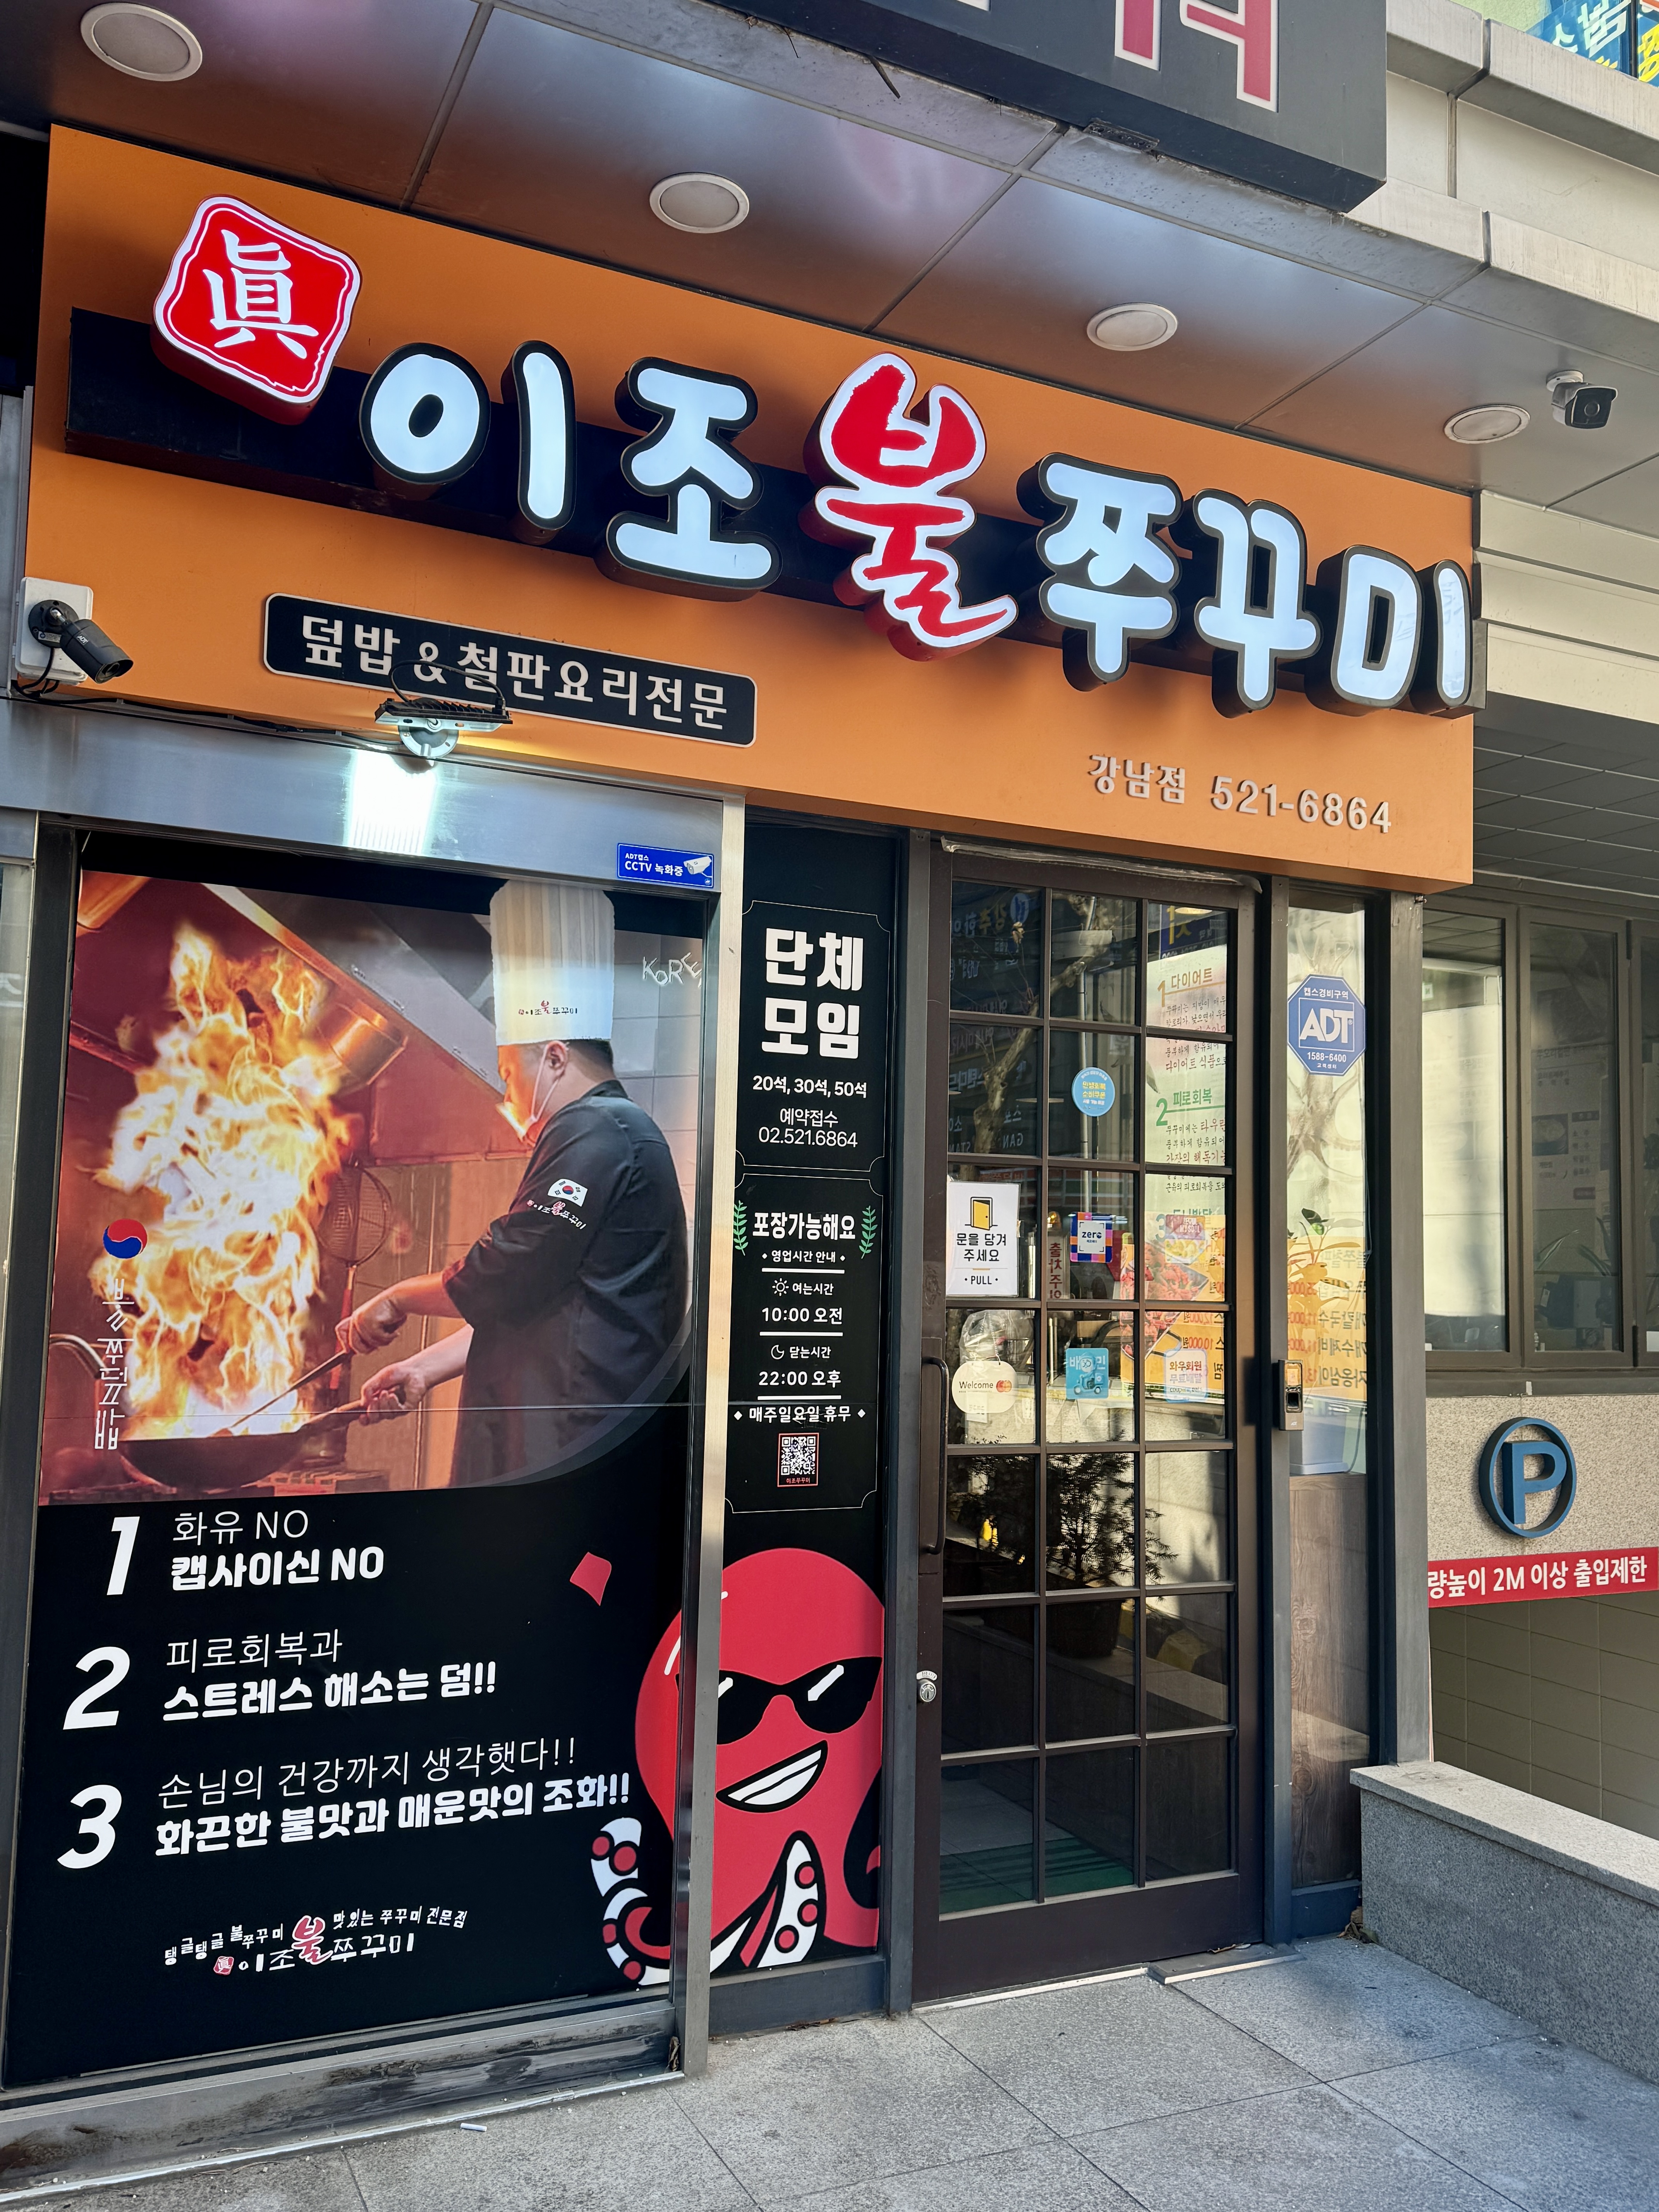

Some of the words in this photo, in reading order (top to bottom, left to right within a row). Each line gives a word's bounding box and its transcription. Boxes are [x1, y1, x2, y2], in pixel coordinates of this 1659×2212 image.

[203, 230, 318, 357] 眞
[77, 635, 88, 644] ADT
[302, 616, 400, 676] 덮밥
[414, 642, 447, 683] &
[458, 642, 728, 730] 철판요리전문
[1089, 754, 1185, 804] 강남점
[1212, 775, 1391, 833] 521-6864
[625, 861, 652, 872] CCTV
[655, 863, 683, 876] 녹화중
[765, 928, 863, 991] 단체
[642, 952, 702, 988] KORE
[1171, 968, 1212, 989] 다이어트
[1192, 999, 1209, 1010] 지방이
[762, 997, 860, 1059] 모임
[1192, 1012, 1214, 1024] 낮으면서
[1300, 1008, 1353, 1043] ADT
[1166, 1058, 1197, 1073] 다이어트
[1307, 1052, 1346, 1063] 1588-6400
[753, 1075, 790, 1094] 20석,
[794, 1079, 831, 1098] 30석,
[835, 1081, 867, 1098] 50석
[1156, 1098, 1168, 1127] 2
[1173, 1088, 1212, 1106] 피로회복
[780, 1108, 838, 1128] 예약접수
[758, 1127, 858, 1148] 02.521.6864
[1166, 1139, 1193, 1149] 풍부하게
[1166, 1182, 1182, 1192] 근육의
[1184, 1181, 1214, 1192] 피로회복을
[752, 1211, 856, 1240] 포장가능해요
[957, 1233, 979, 1246] 문을
[985, 1233, 1006, 1246] 당겨
[771, 1250, 813, 1263] 영업시간
[816, 1251, 836, 1263] 안내
[964, 1249, 1000, 1262] 주세요
[792, 1282, 834, 1295] 여는시간
[971, 1276, 992, 1285] PULL
[762, 1307, 810, 1322] 10:00
[813, 1307, 843, 1325] 오전
[789, 1346, 831, 1359] 닫는시간
[1170, 1361, 1202, 1371] 와우회원
[758, 1371, 808, 1386] 22:00
[811, 1370, 841, 1388] 오후
[959, 1381, 993, 1389] Welcome
[1170, 1373, 1202, 1384] 무료배달
[749, 1406, 819, 1423] 매주일요일
[823, 1406, 851, 1422] 휴무
[1506, 1441, 1567, 1525] P
[106, 1516, 140, 1595] 1
[173, 1511, 243, 1546] 화유
[256, 1510, 308, 1539] NO
[171, 1549, 320, 1591] 캡사이신
[331, 1546, 384, 1581] NO
[1493, 1566, 1525, 1592] 2M
[1531, 1561, 1568, 1590] 이상
[1573, 1555, 1647, 1588] 출입제한
[167, 1628, 343, 1673] 피로회복과
[63, 1646, 130, 1730] 2
[163, 1677, 312, 1721] 스트레스
[323, 1668, 428, 1707] 해소는
[440, 1662, 496, 1698] 덤!!
[158, 1764, 263, 1810] 손님의
[278, 1751, 410, 1797] 건강까지
[422, 1737, 576, 1783] 생각햇다!!
[57, 1784, 122, 1869] 3
[155, 1810, 269, 1857] 화끈한
[280, 1798, 389, 1842] 불맛과
[398, 1782, 534, 1831] 매운맛의
[542, 1772, 630, 1814] 조화!!
[333, 1908, 373, 1930] 맛있는
[380, 1906, 422, 1925] 쭈꾸미
[426, 1906, 467, 1929] 전문점
